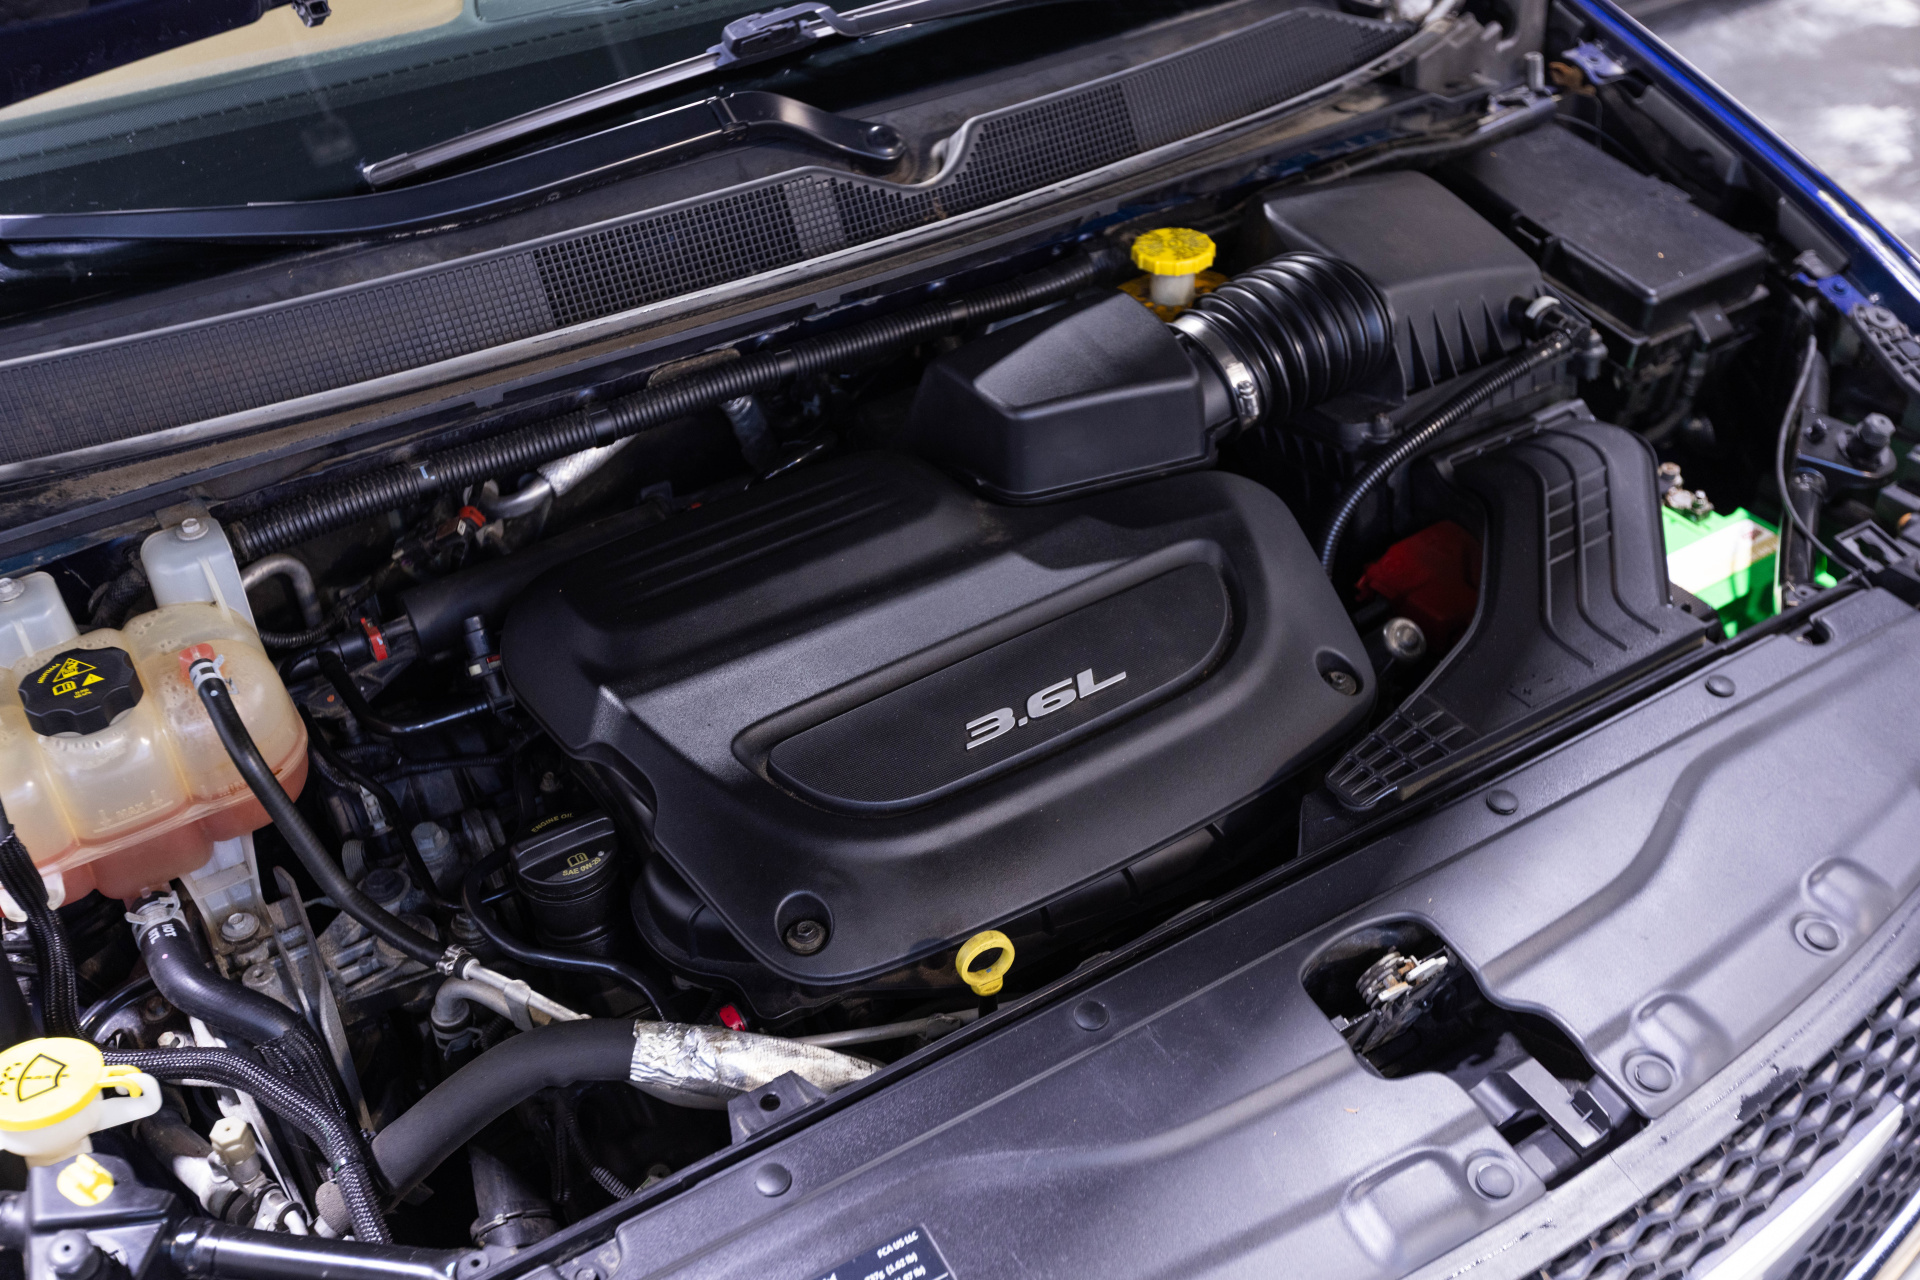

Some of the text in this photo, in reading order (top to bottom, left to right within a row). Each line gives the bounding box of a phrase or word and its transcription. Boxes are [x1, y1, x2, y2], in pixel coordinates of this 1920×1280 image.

[966, 668, 1127, 750] 3.6L
[531, 815, 560, 833] ENGINE
[562, 867, 580, 877] SAE
[876, 1230, 919, 1259] FCA US LLC
